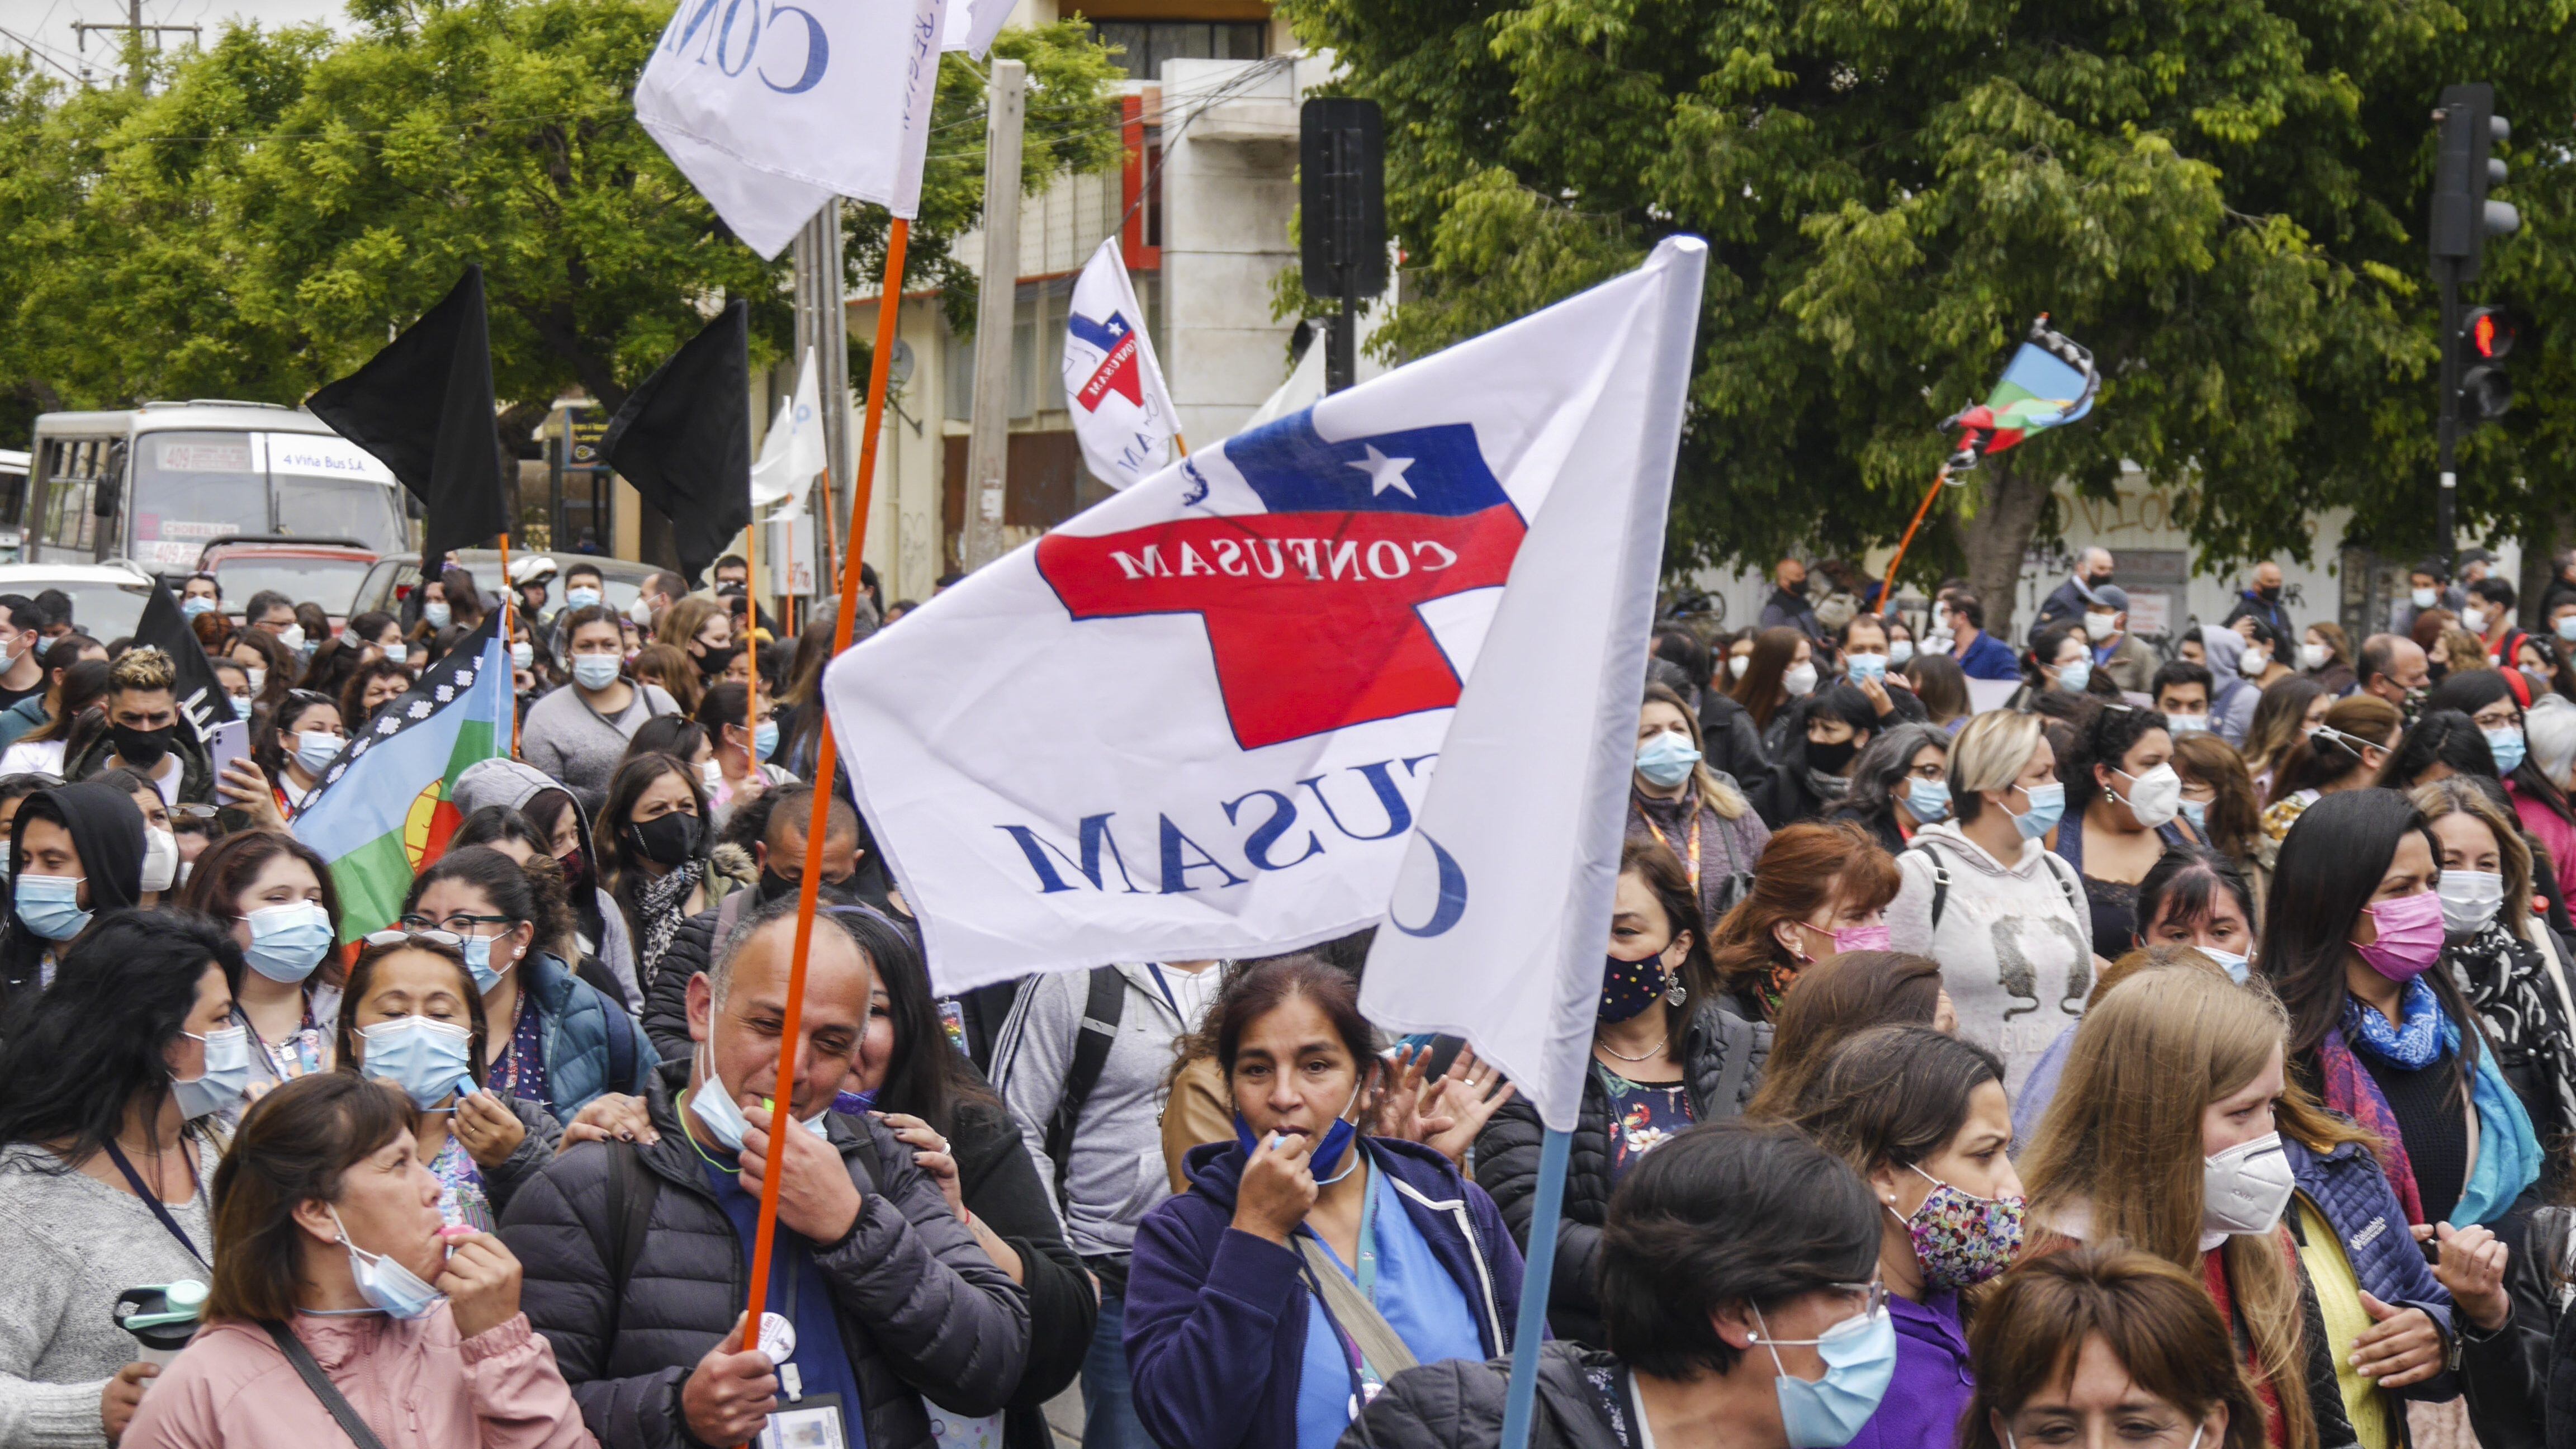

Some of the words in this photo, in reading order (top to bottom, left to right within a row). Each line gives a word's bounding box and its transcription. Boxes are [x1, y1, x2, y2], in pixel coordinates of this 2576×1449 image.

[166, 447, 191, 468] 409
[283, 454, 292, 465] 4
[295, 454, 321, 467] Viña
[325, 456, 345, 468] Bus
[155, 543, 179, 564] 409
